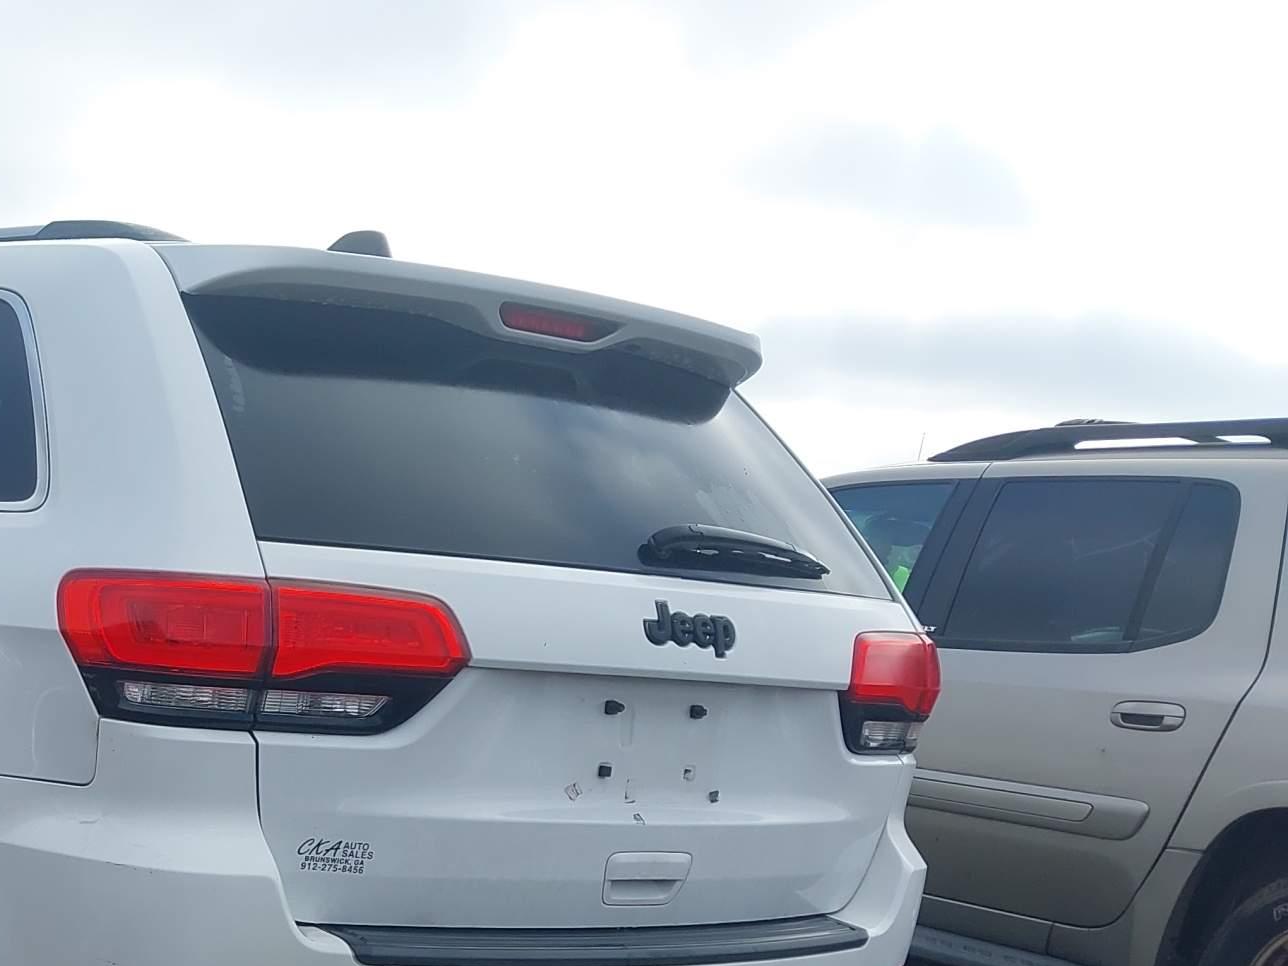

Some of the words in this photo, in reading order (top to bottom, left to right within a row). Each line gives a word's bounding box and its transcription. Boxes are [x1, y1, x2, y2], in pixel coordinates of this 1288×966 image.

[643, 599, 736, 659] Jeep
[297, 838, 343, 857] CKA
[342, 841, 370, 851] AUTO
[341, 849, 374, 860] SALES
